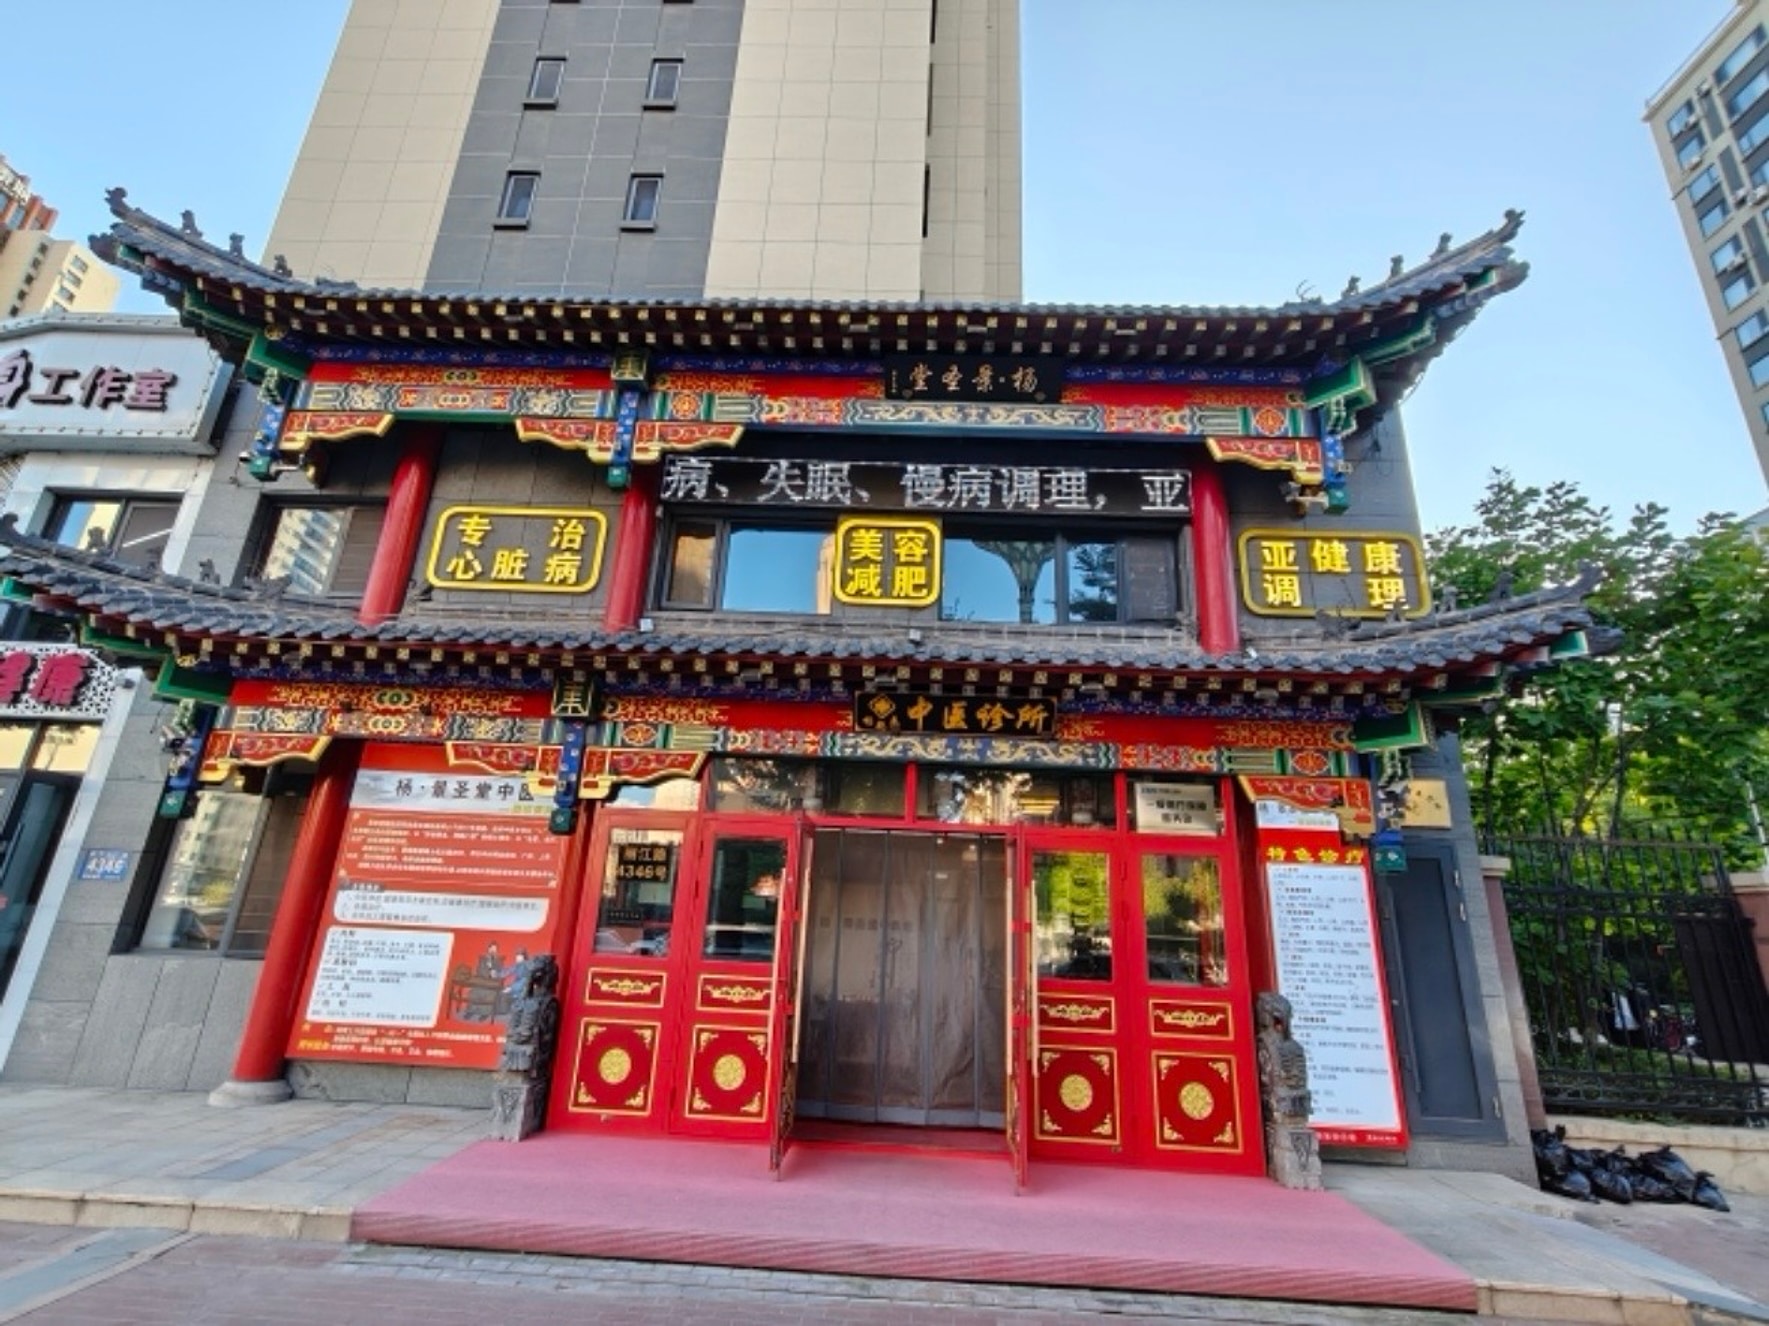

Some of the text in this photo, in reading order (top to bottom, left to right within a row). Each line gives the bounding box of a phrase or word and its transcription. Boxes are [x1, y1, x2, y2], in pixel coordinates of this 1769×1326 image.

[457, 514, 586, 549] 专治
[849, 528, 928, 563] 美容
[445, 549, 582, 584] 心脏病
[1260, 539, 1403, 574] 亚健康
[846, 565, 929, 598] 减肥
[1263, 574, 1410, 609] 调理
[906, 696, 1048, 734] 中医诊所
